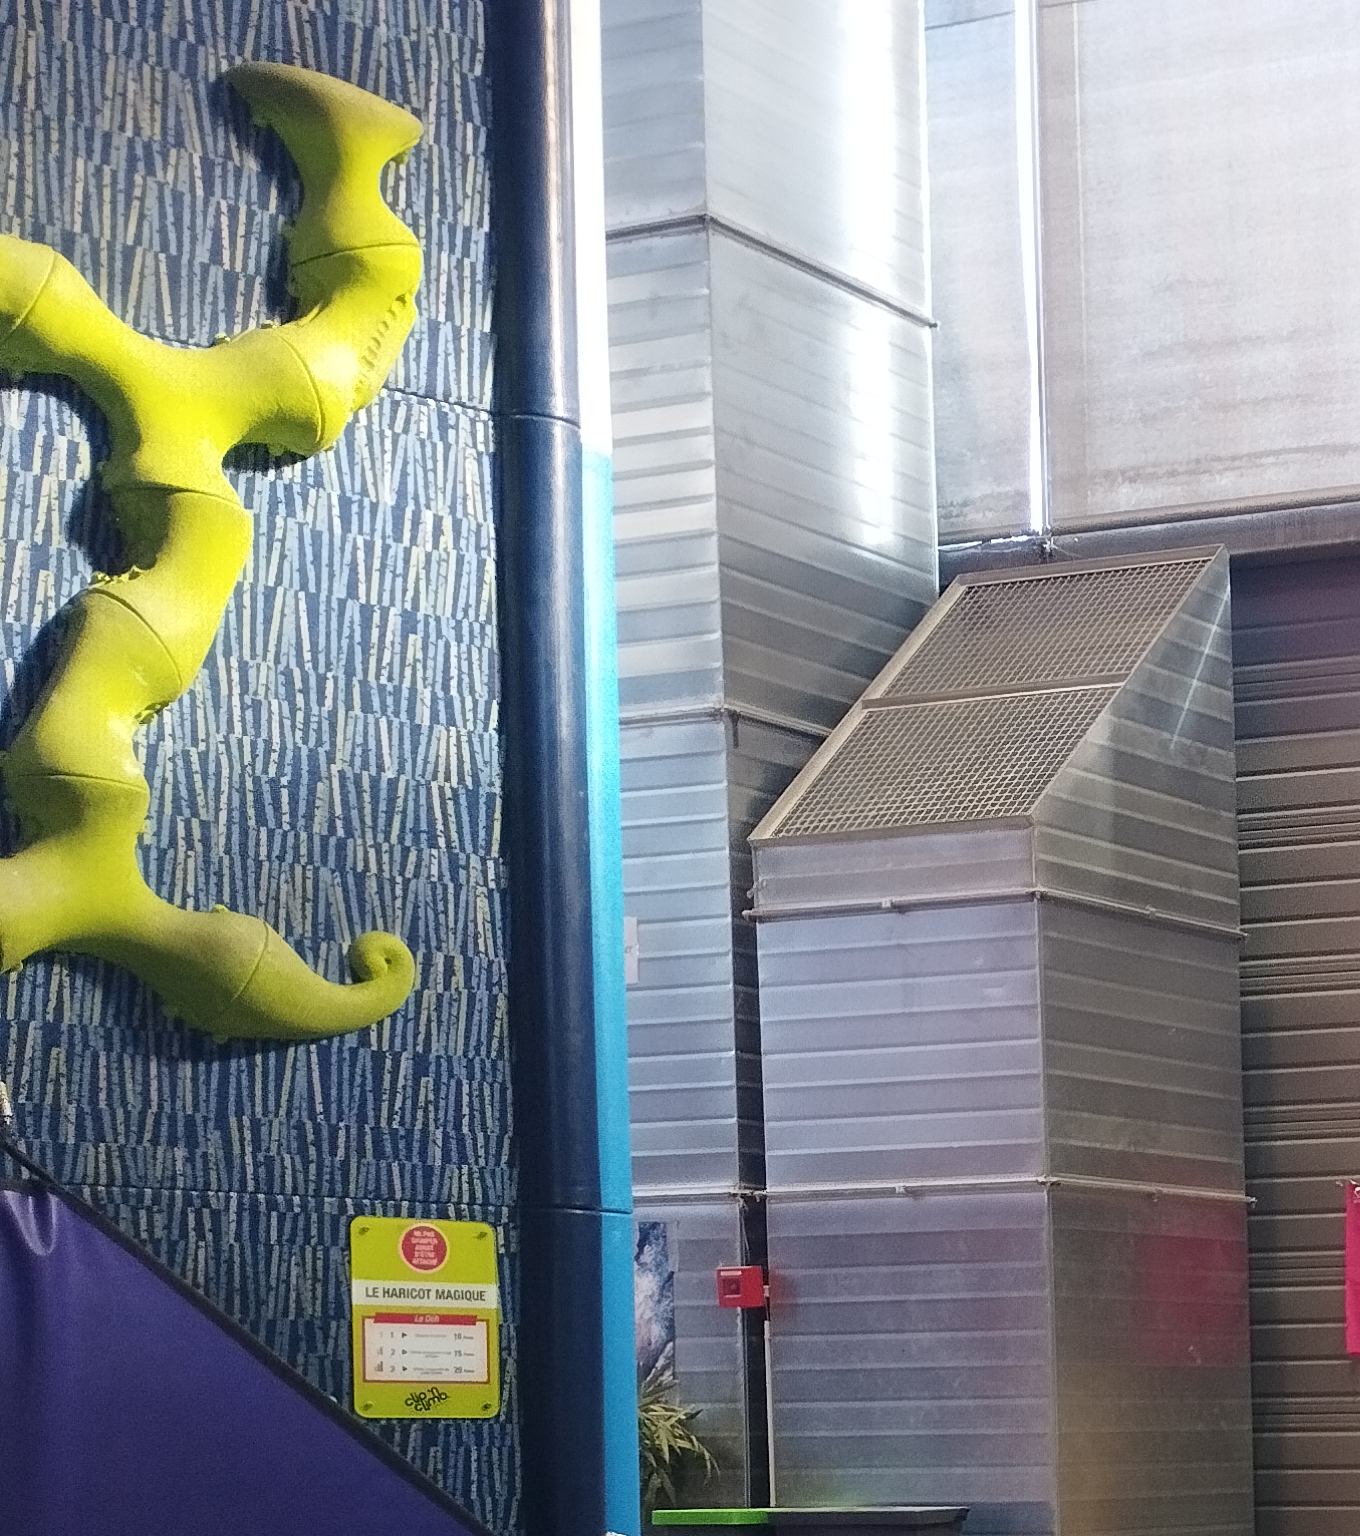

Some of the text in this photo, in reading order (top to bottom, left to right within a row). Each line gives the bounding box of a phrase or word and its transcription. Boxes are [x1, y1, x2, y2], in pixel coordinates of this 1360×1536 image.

[365, 1286, 486, 1302] LE HARICOT MAGIQUE
